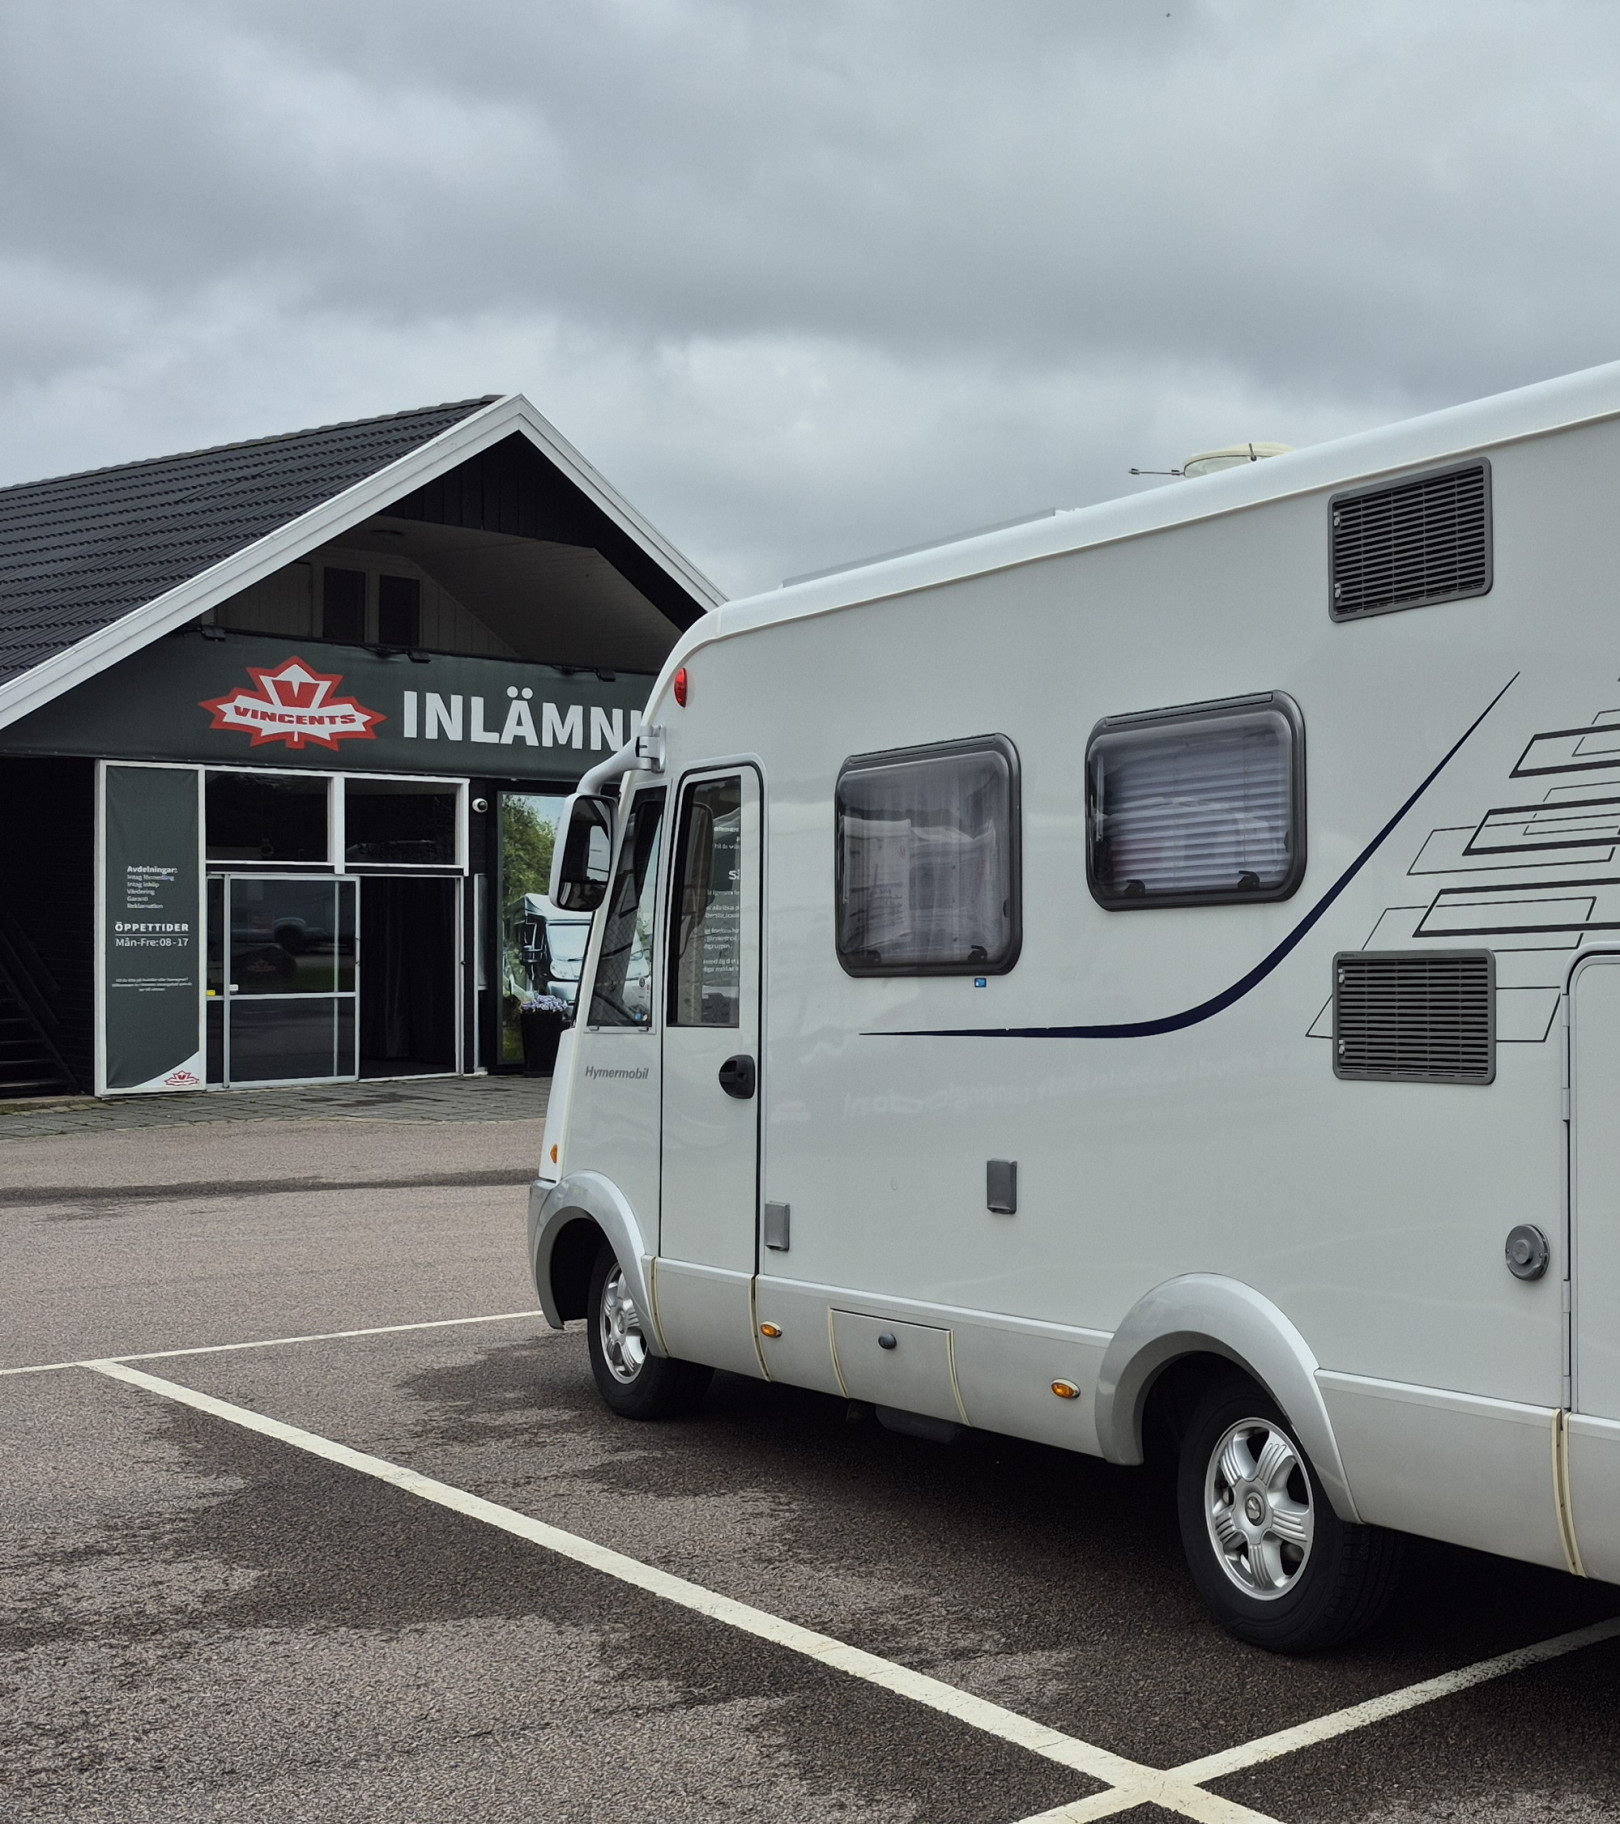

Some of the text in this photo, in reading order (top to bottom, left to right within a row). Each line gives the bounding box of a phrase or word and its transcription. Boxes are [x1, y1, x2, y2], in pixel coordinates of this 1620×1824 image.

[234, 705, 356, 725] VINCENTS
[126, 865, 178, 875] Avdelningar:
[115, 921, 189, 932] ÖPPETTIDER
[585, 1065, 650, 1080] Hymermobil
